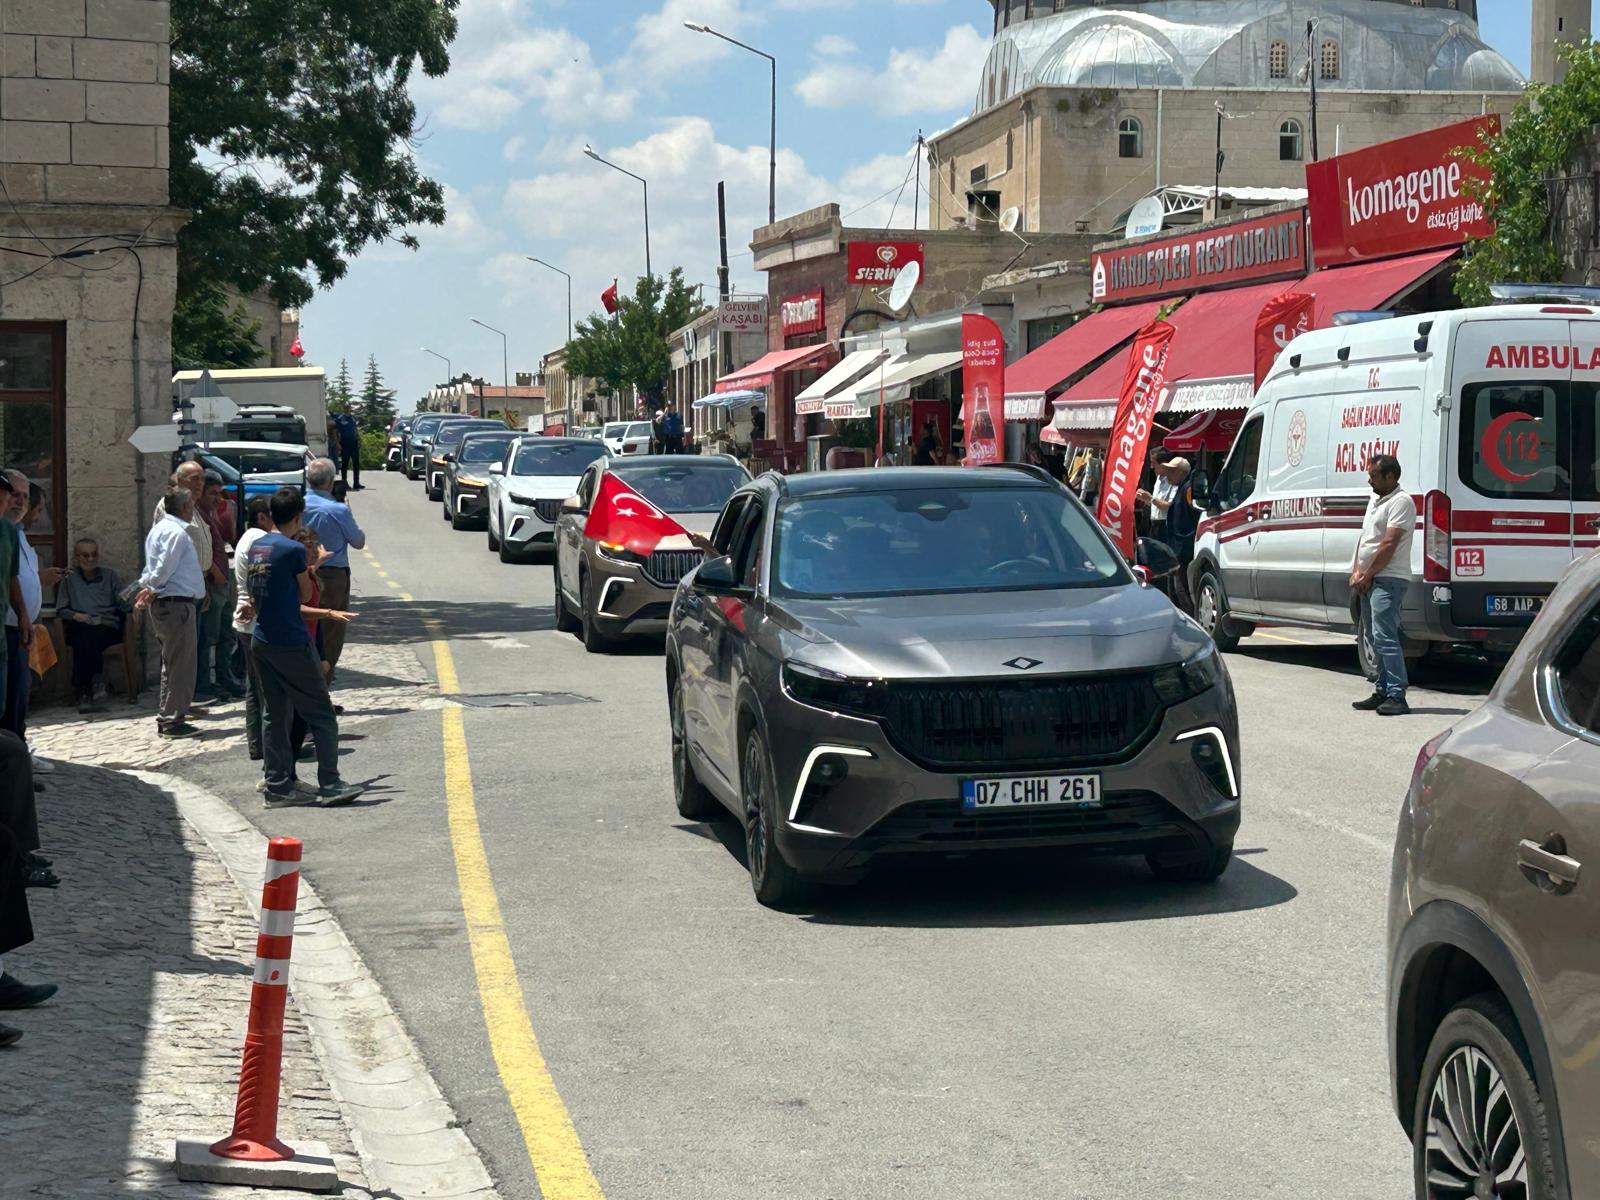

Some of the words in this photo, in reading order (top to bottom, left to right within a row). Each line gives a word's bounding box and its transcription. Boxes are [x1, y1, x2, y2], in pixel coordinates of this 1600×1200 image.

[1347, 162, 1460, 226] komagene
[1196, 220, 1299, 276] RESTAURANT
[1341, 404, 1364, 429] SAĞLIK
[1364, 400, 1402, 427] BAKANLIĞI
[1101, 343, 1160, 540] komagene
[1504, 431, 1540, 460] 112
[1335, 442, 1356, 473] ACİL
[1270, 497, 1321, 519] AMBULANS
[1459, 551, 1480, 565] 112
[1494, 598, 1508, 611] 68
[1514, 598, 1534, 611] AAP
[976, 781, 1000, 804] 07
[1011, 779, 1049, 804] CHH
[1060, 777, 1095, 801] 261
